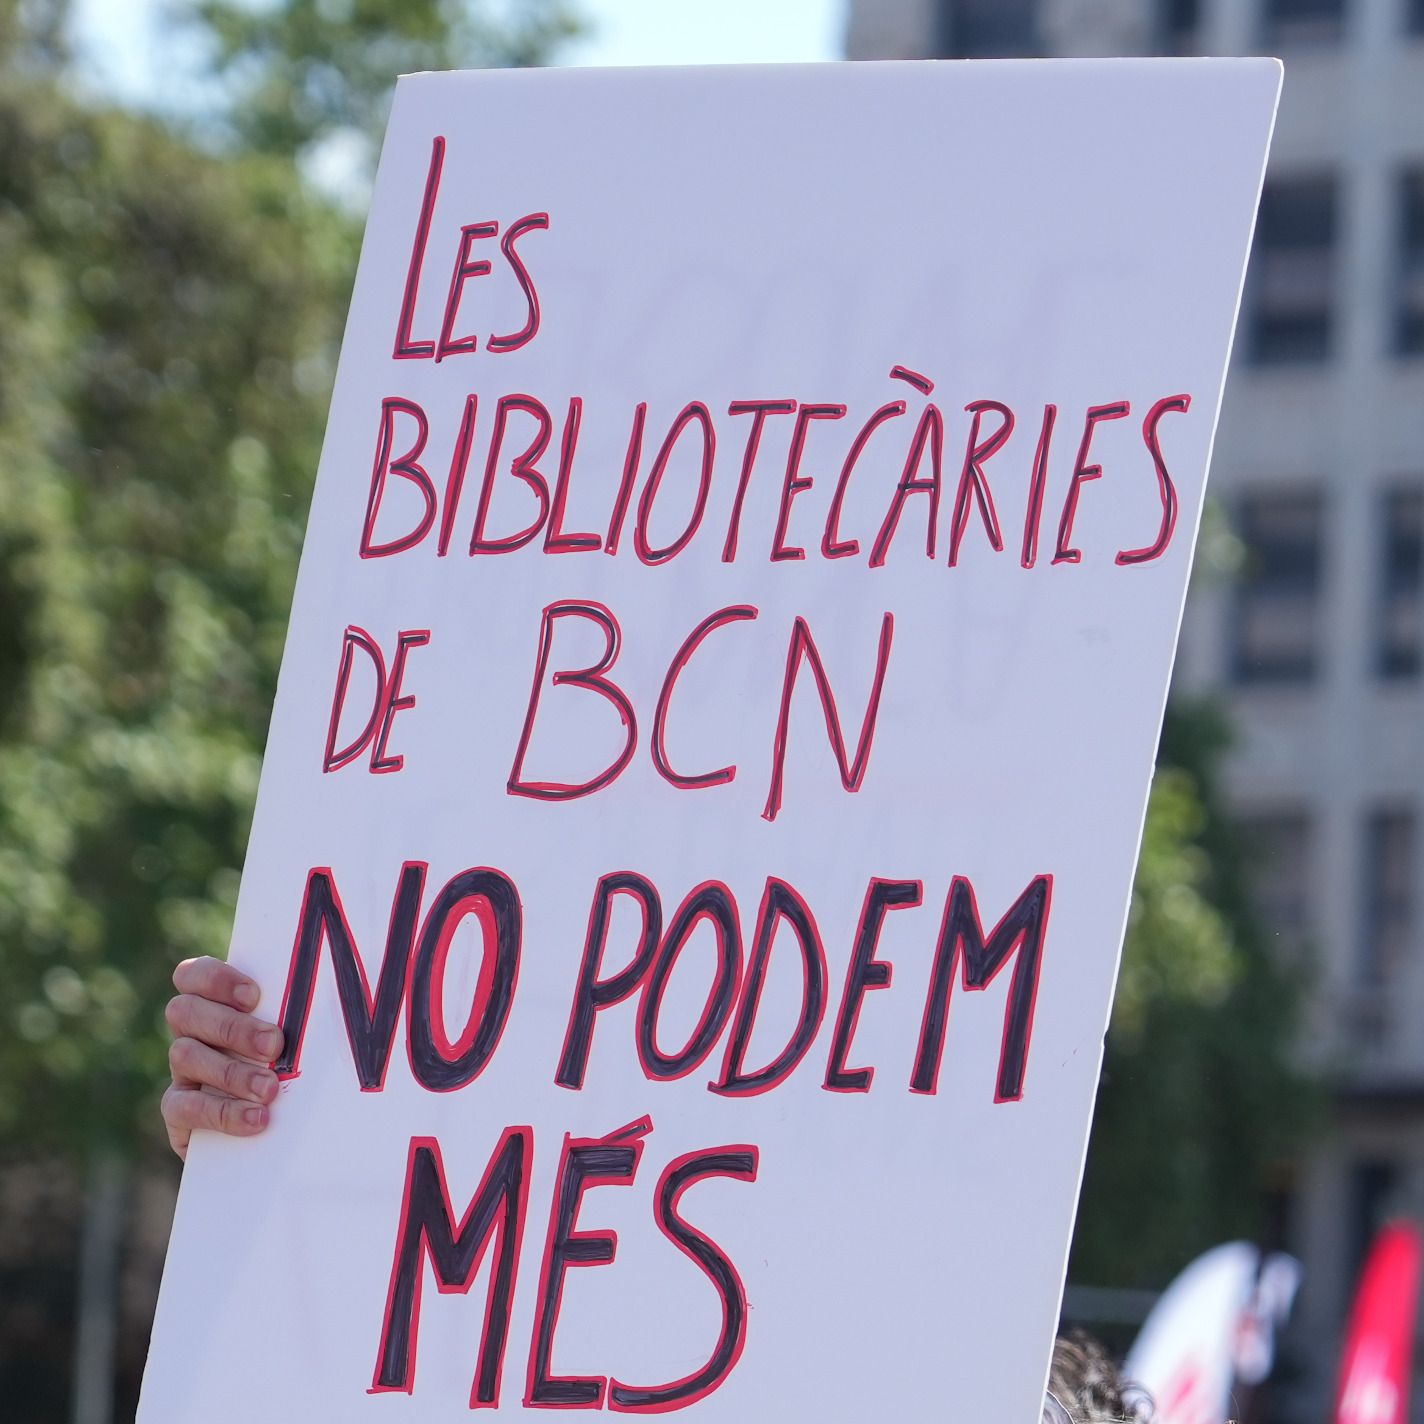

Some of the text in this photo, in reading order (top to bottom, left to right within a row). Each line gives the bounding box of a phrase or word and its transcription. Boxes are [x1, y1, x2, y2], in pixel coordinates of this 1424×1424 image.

[393, 136, 550, 362] LES
[358, 365, 1191, 570] BIBLIOTECÀRIES
[323, 599, 895, 823] DE BCN
[274, 860, 1054, 1104] NO PODEM
[366, 1114, 760, 1415] MÉS
